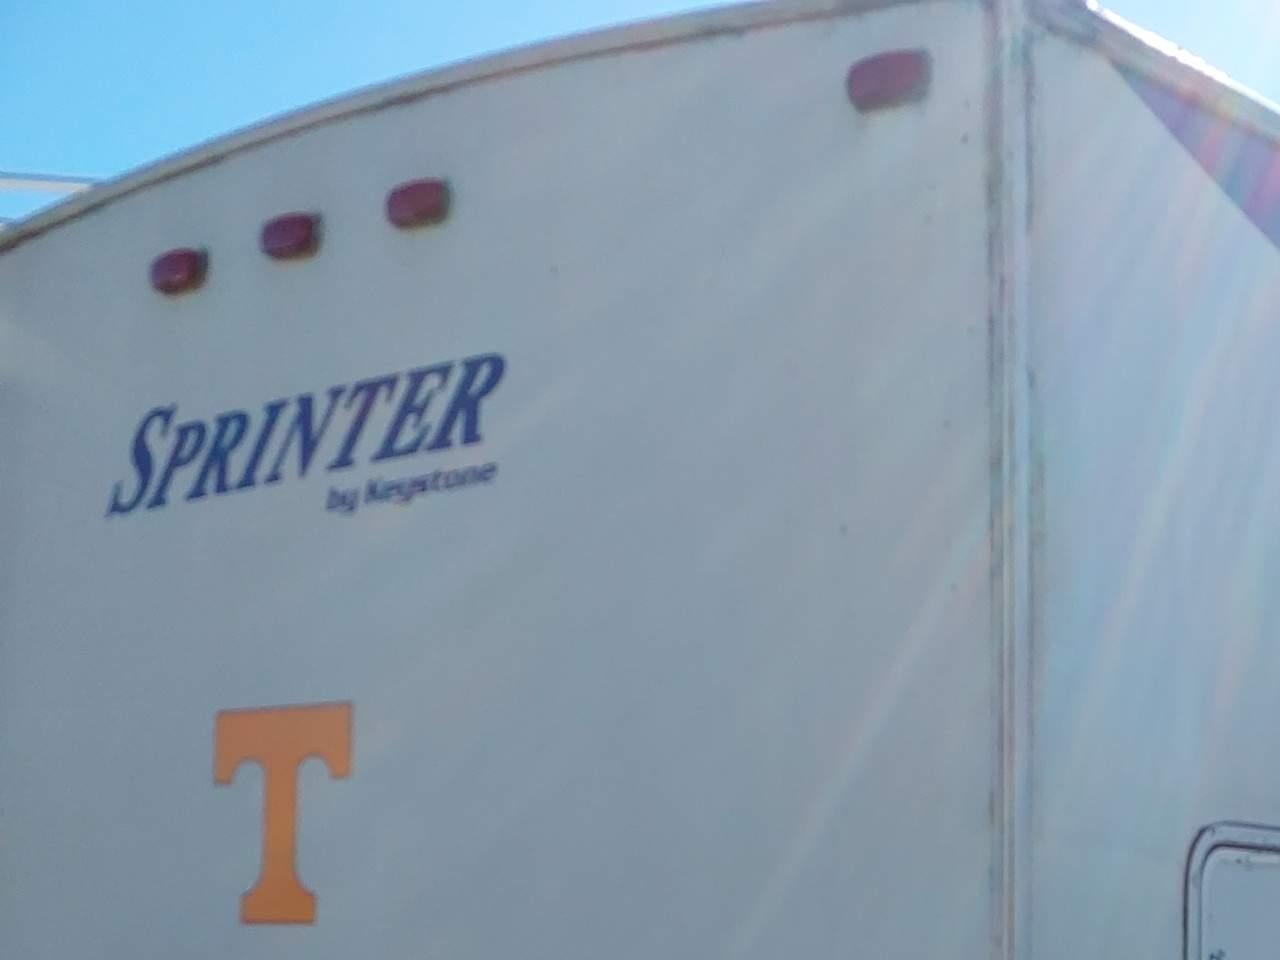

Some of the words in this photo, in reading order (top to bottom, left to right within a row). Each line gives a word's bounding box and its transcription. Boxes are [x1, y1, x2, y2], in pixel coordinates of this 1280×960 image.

[108, 352, 507, 517] SPRINTER
[325, 484, 358, 513] by
[365, 462, 498, 503] Keystone
[214, 701, 353, 925] T
